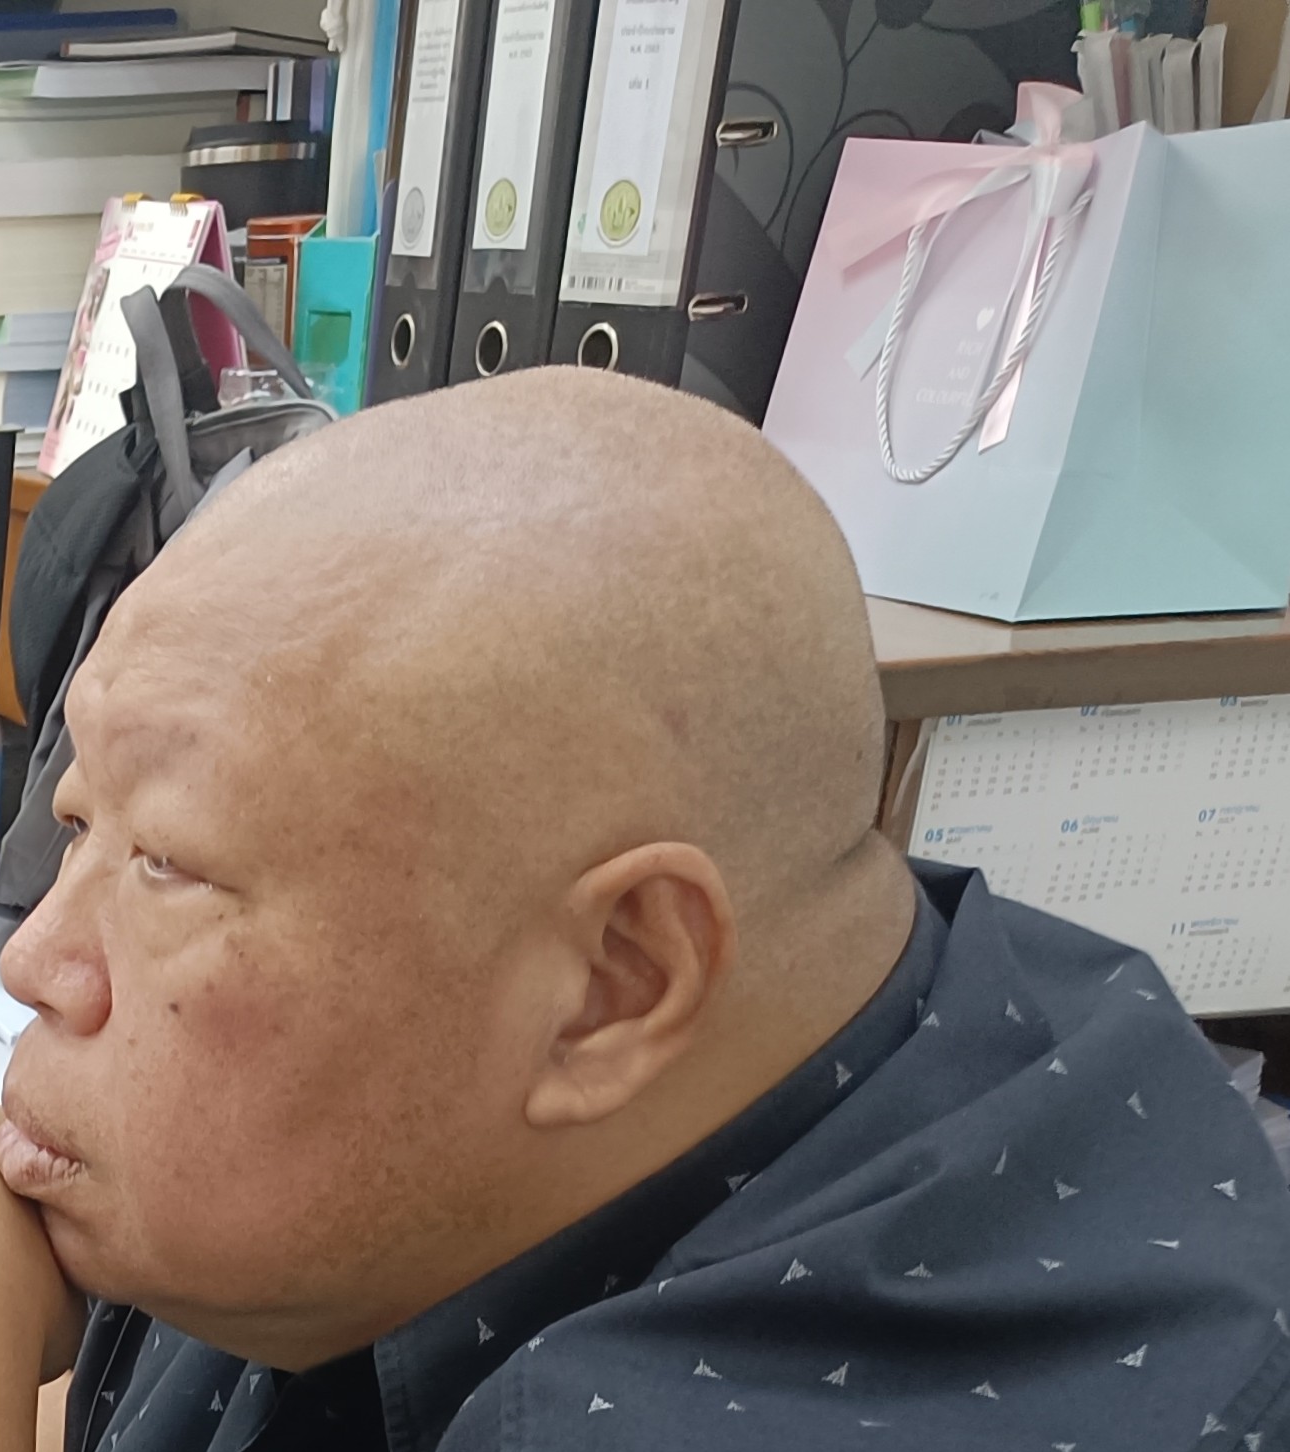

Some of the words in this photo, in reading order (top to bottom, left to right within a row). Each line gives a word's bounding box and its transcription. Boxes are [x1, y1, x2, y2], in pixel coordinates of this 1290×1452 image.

[1197, 808, 1216, 823] 07
[1061, 819, 1079, 833] 06
[924, 829, 944, 843] 05
[1171, 922, 1185, 936] 11
